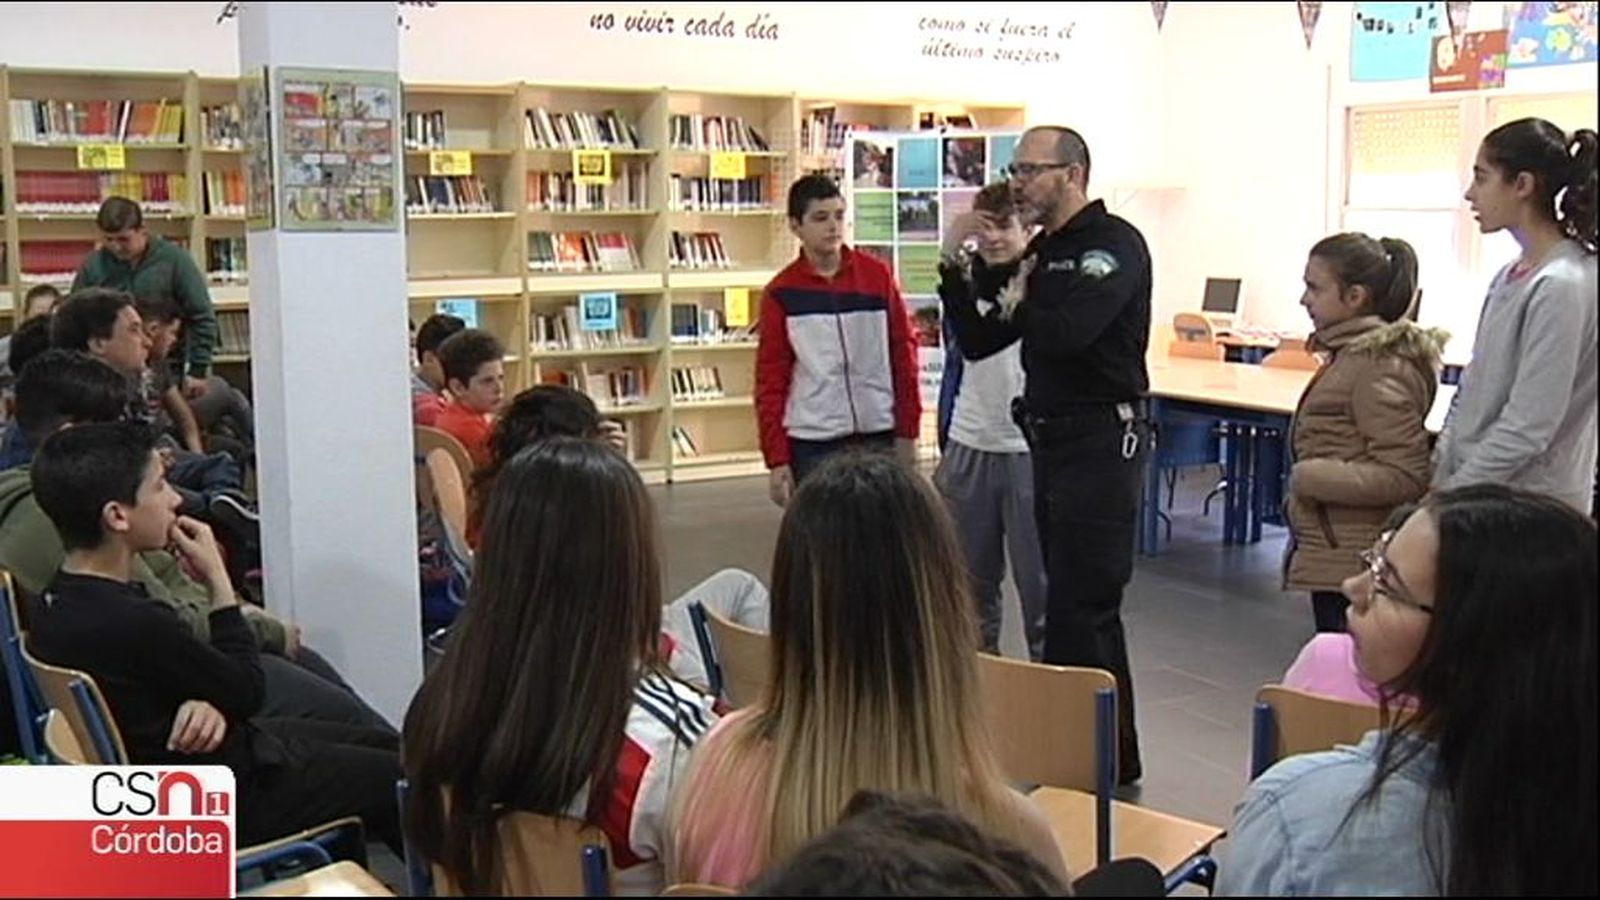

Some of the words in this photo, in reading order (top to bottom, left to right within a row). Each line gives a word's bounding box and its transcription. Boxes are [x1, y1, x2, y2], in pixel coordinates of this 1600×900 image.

[590, 12, 615, 31] no
[624, 9, 675, 34] vivir
[684, 10, 736, 38] cada
[745, 12, 780, 40] día
[918, 16, 966, 32] como
